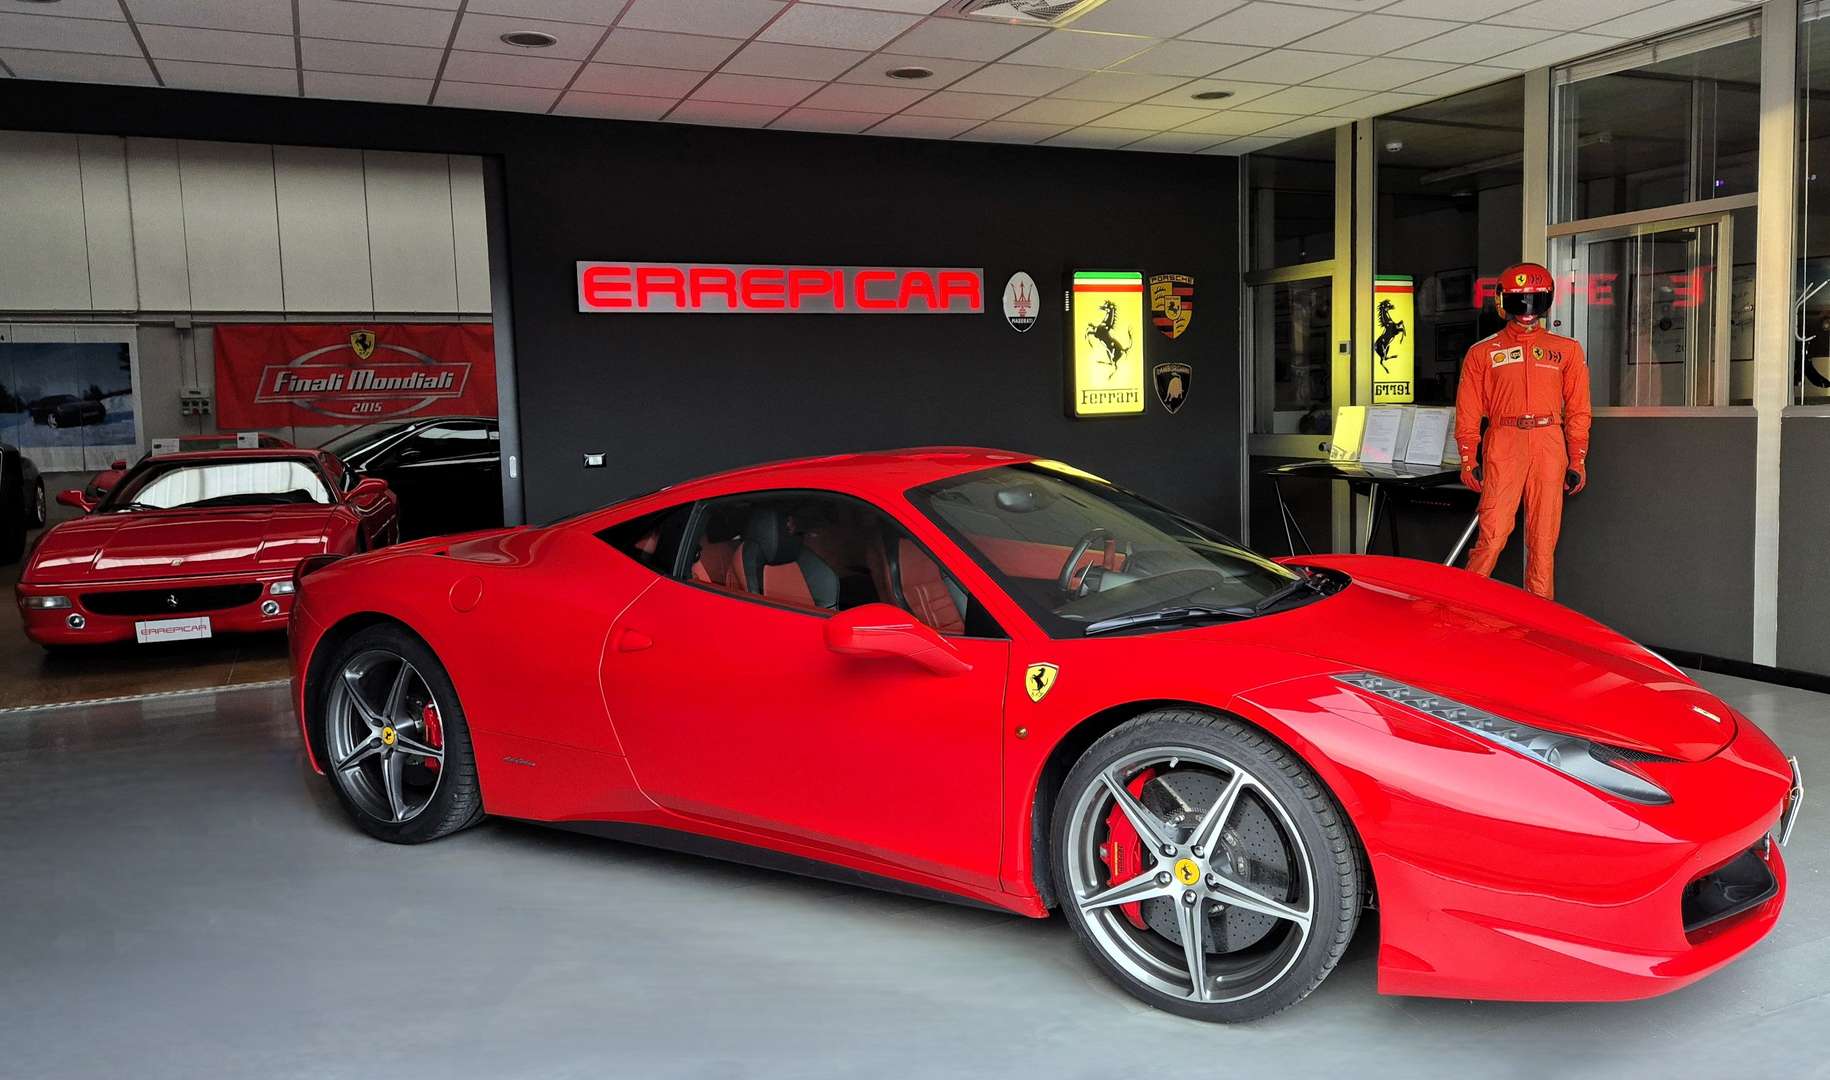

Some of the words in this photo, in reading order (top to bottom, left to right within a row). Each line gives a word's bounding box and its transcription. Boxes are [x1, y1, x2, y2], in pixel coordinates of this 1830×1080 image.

[1151, 274, 1194, 284] PORSCHE
[273, 371, 344, 393] Finali
[347, 369, 454, 391] Mondiali
[1080, 388, 1139, 405] Ferrari
[352, 402, 383, 413] 2015
[140, 624, 207, 636] ERREPICAR
